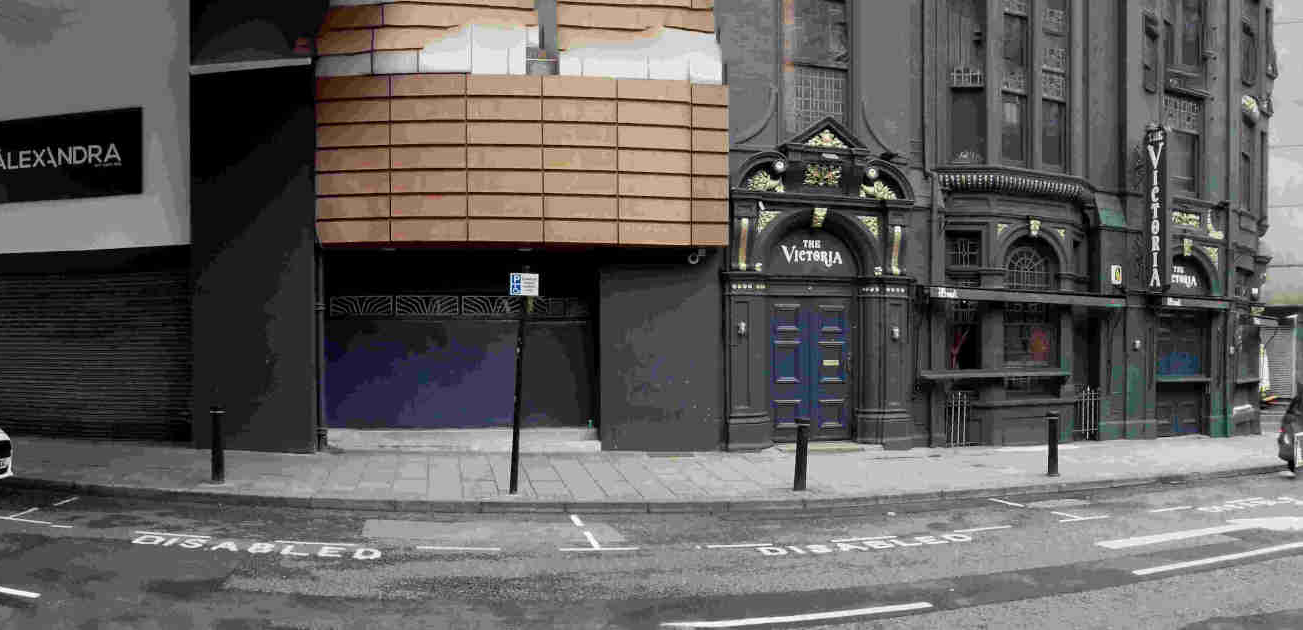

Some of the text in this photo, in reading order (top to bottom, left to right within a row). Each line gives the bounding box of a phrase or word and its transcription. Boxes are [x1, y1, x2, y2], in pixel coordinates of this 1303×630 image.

[1147, 142, 1165, 288] VICTORIA
[802, 239, 821, 249] THE
[131, 534, 382, 560] DISABLED
